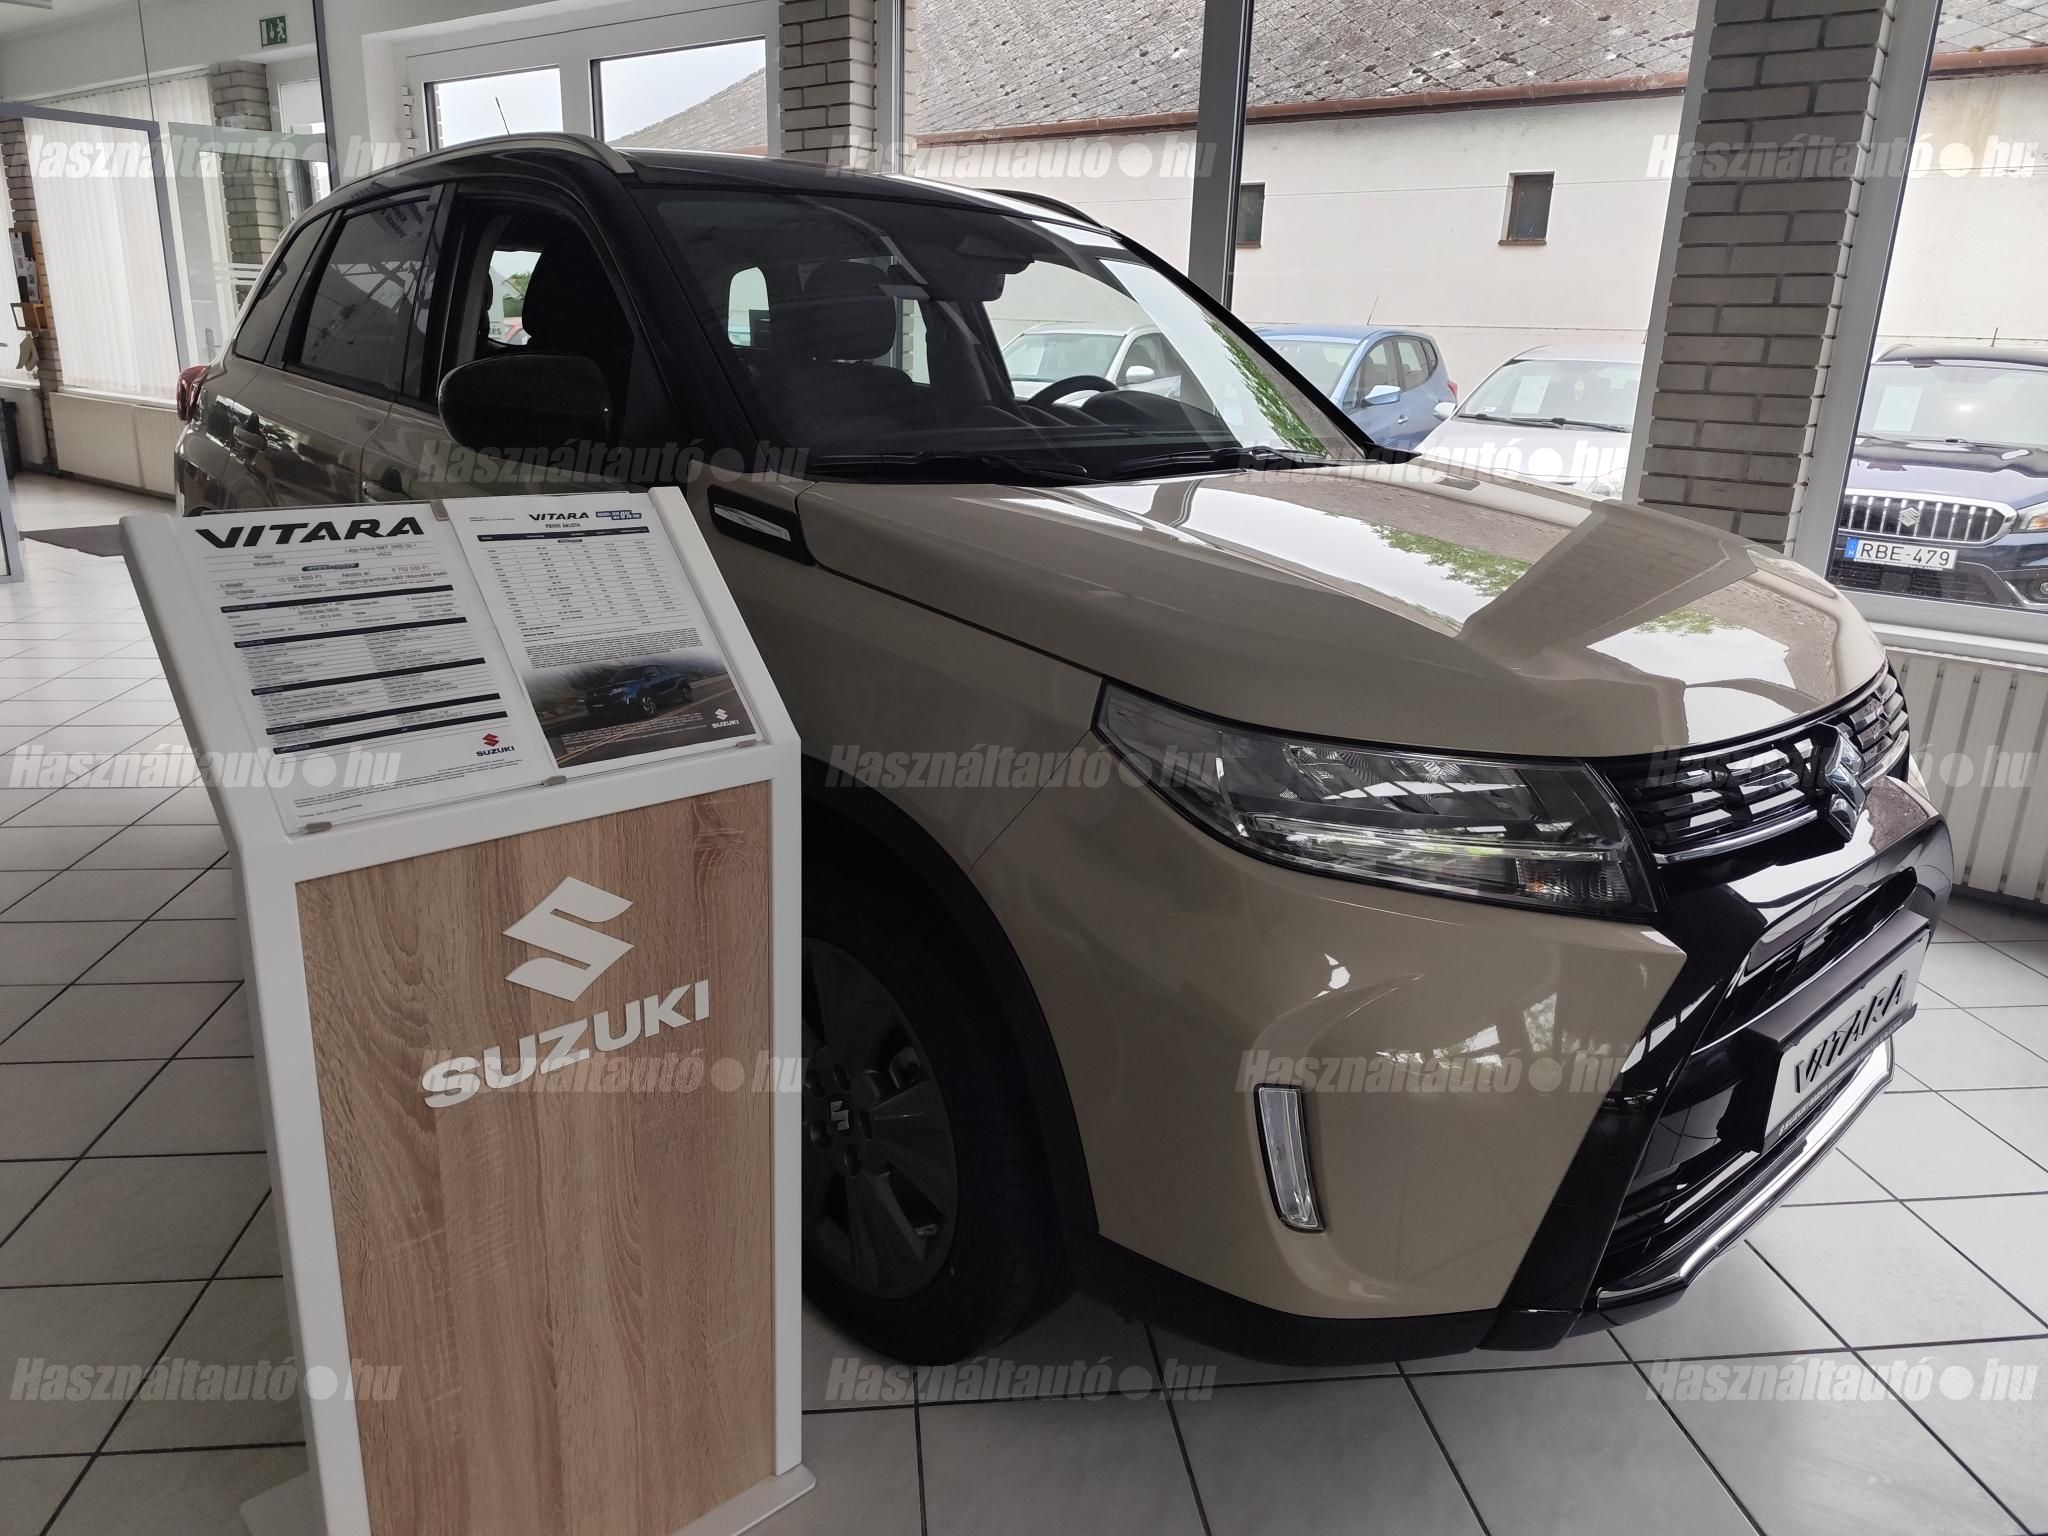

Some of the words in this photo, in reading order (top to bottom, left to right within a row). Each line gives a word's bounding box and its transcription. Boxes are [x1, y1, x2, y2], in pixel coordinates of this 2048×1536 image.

[528, 512, 590, 521] VITARA
[195, 516, 425, 549] VITARA
[1860, 542, 1950, 567] RBE-479
[711, 718, 741, 729] SUZUKI
[476, 745, 516, 757] SUZUKI
[421, 978, 710, 1109] SUZUKI
[1794, 969, 1908, 1093] VITARA
